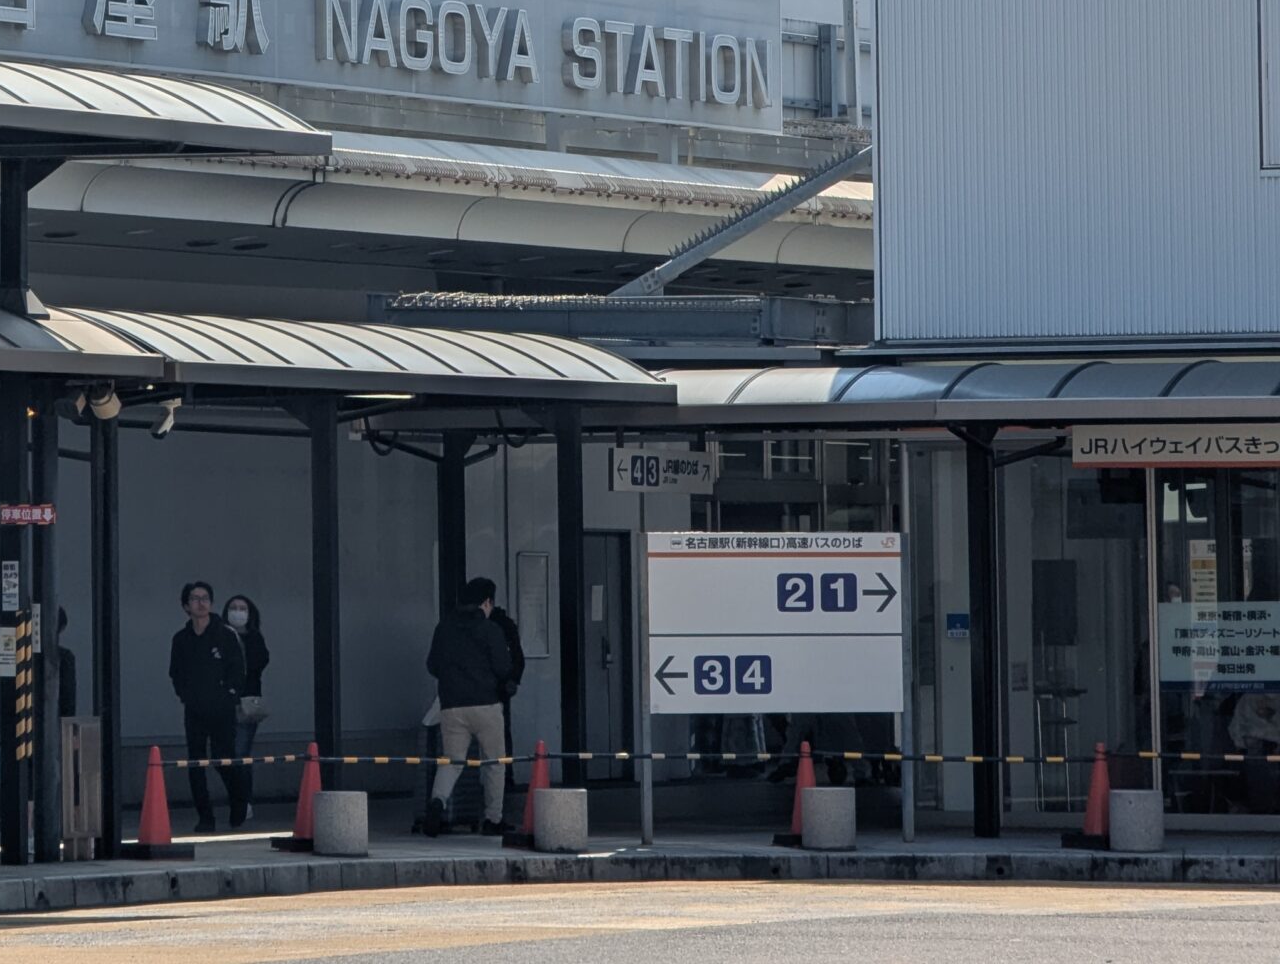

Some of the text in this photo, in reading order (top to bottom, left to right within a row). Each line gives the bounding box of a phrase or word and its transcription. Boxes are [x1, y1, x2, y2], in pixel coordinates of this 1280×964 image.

[562, 16, 773, 109] STATION
[1080, 436, 1280, 456] JRハイウェイバスきっ
[685, 537, 863, 550] 名古屋駅(新幹線口)高速バスのりば
[785, 577, 807, 608] 2
[701, 659, 765, 691] 3 4
